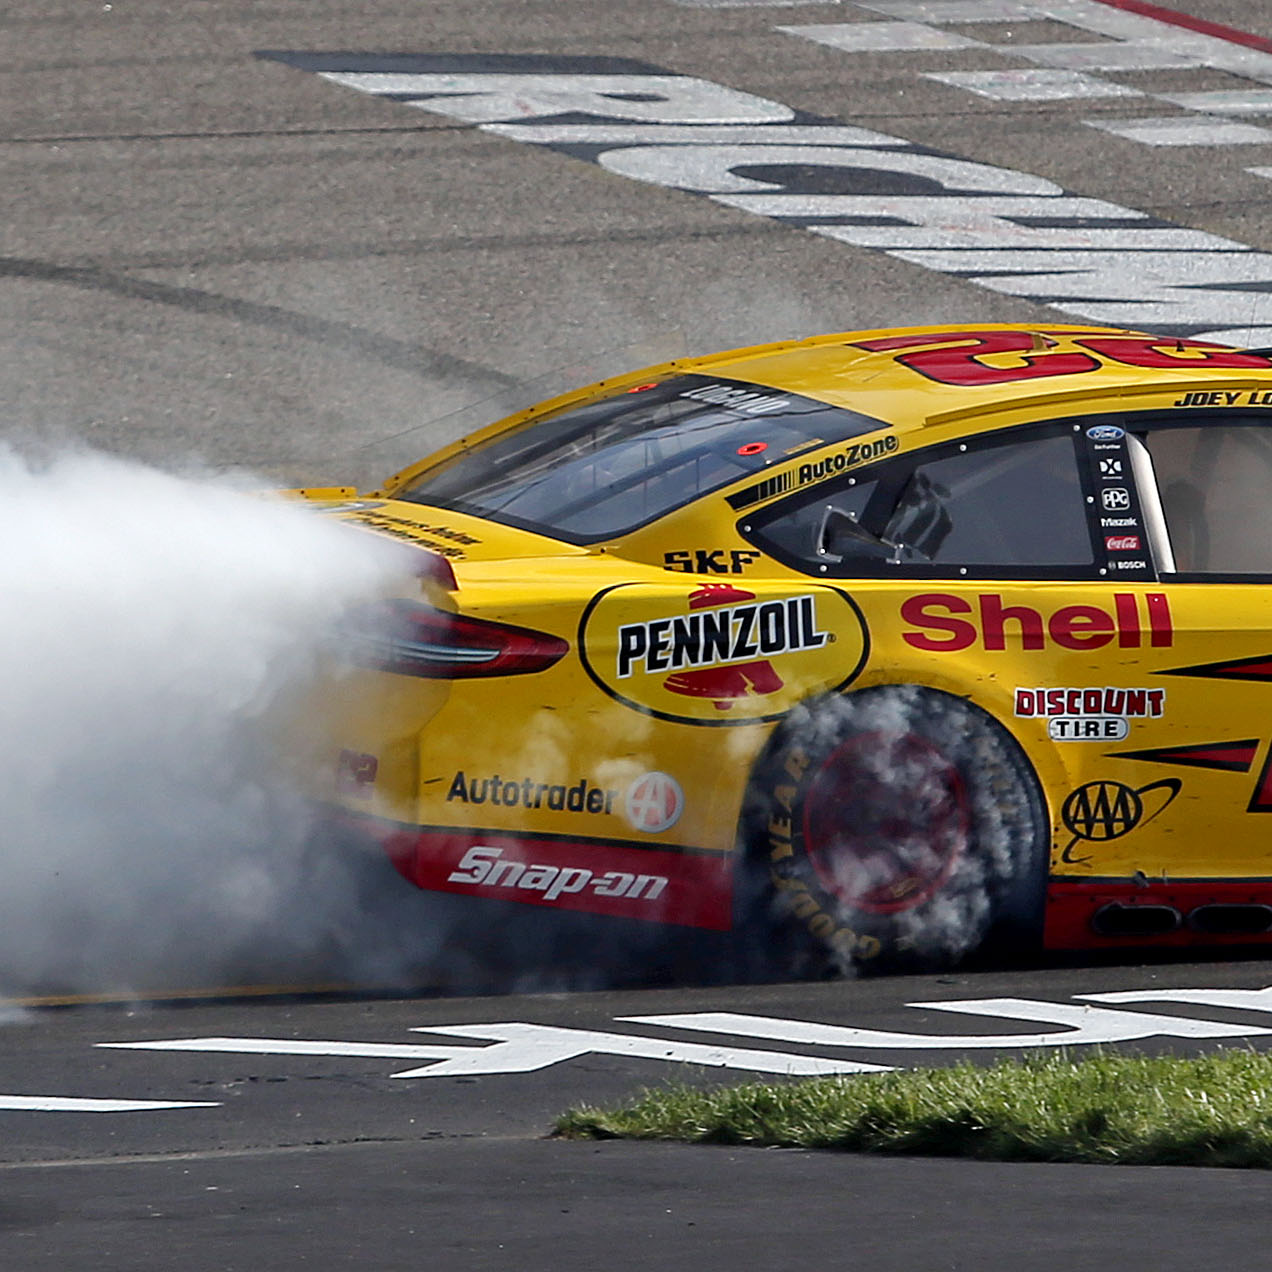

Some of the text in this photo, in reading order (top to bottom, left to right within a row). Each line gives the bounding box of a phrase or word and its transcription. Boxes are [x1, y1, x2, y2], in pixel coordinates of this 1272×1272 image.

[1173, 391, 1240, 407] JOEY
[798, 434, 899, 485] AutoZone
[1103, 491, 1128, 508] PPG
[1101, 517, 1138, 527] Mazak
[663, 549, 760, 574] SKF
[1118, 560, 1147, 570] BOSCH
[617, 595, 827, 678] PENNZOIL
[899, 592, 1174, 652] Shell
[1015, 686, 1165, 717] DISCOUNT
[1055, 720, 1119, 737] TIRE
[446, 771, 618, 815] Autotrader
[1070, 782, 1135, 840] AAA
[447, 846, 669, 901] Snap-on
